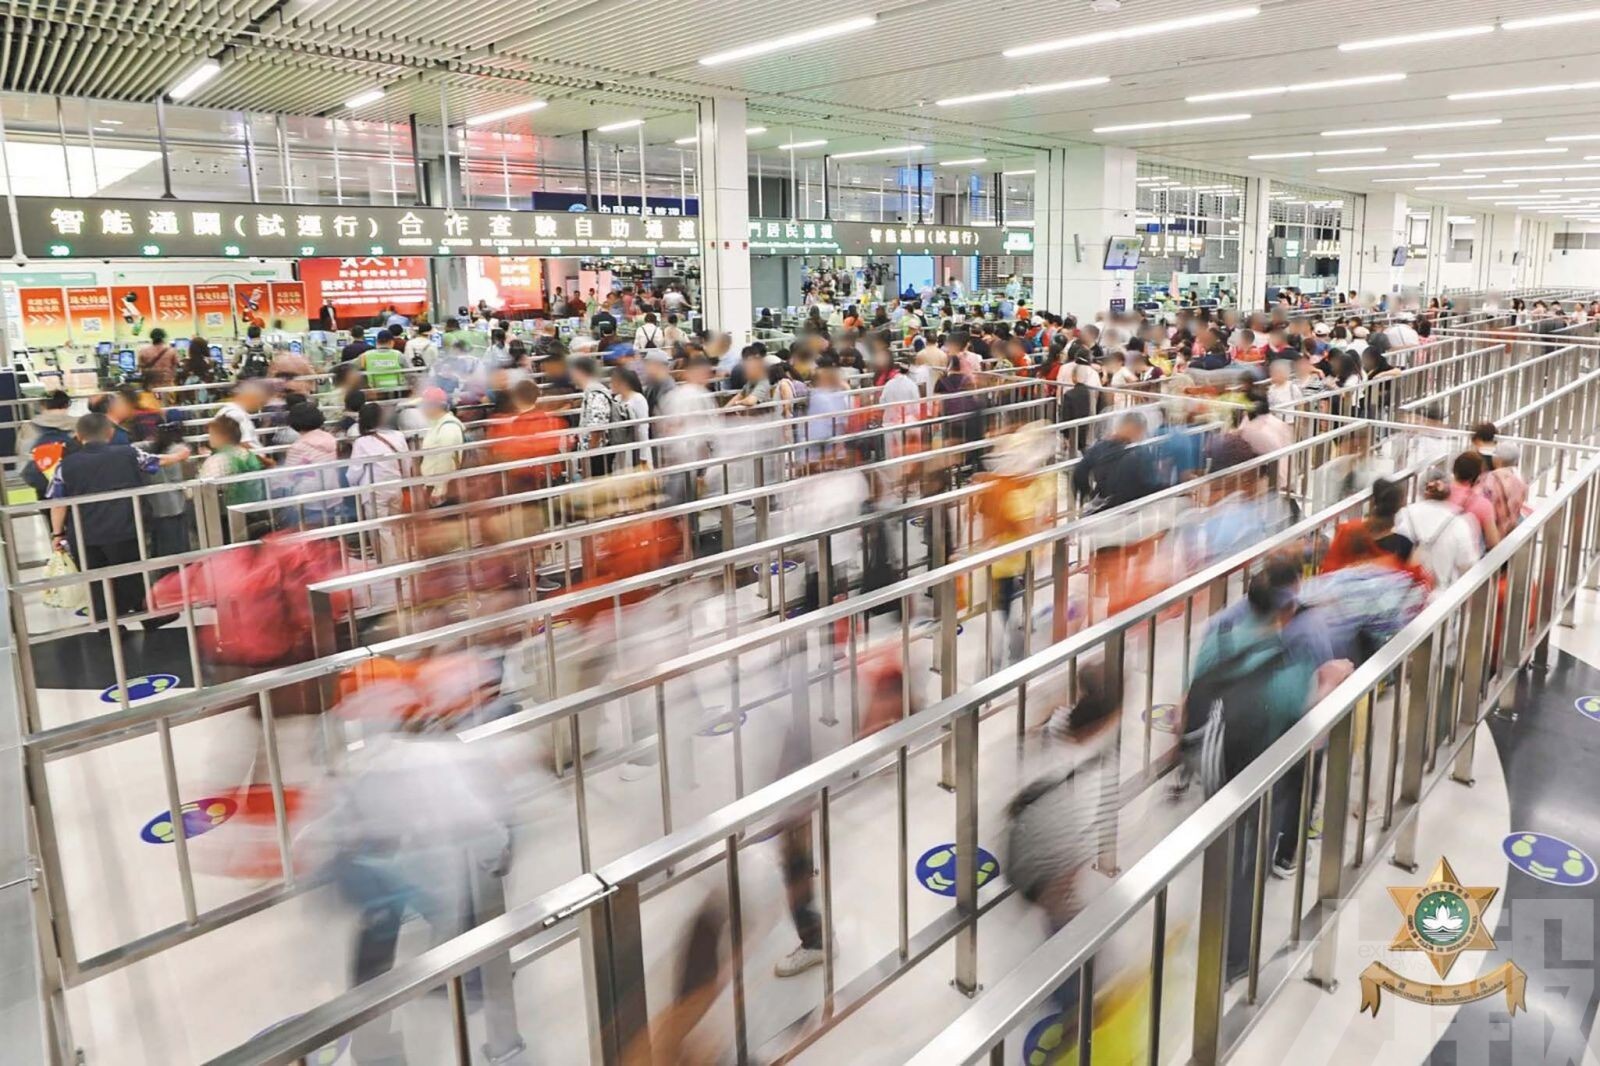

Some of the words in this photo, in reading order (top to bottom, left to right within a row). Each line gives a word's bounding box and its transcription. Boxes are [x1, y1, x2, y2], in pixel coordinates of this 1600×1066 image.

[397, 210, 696, 239] 合作查驗自助通道
